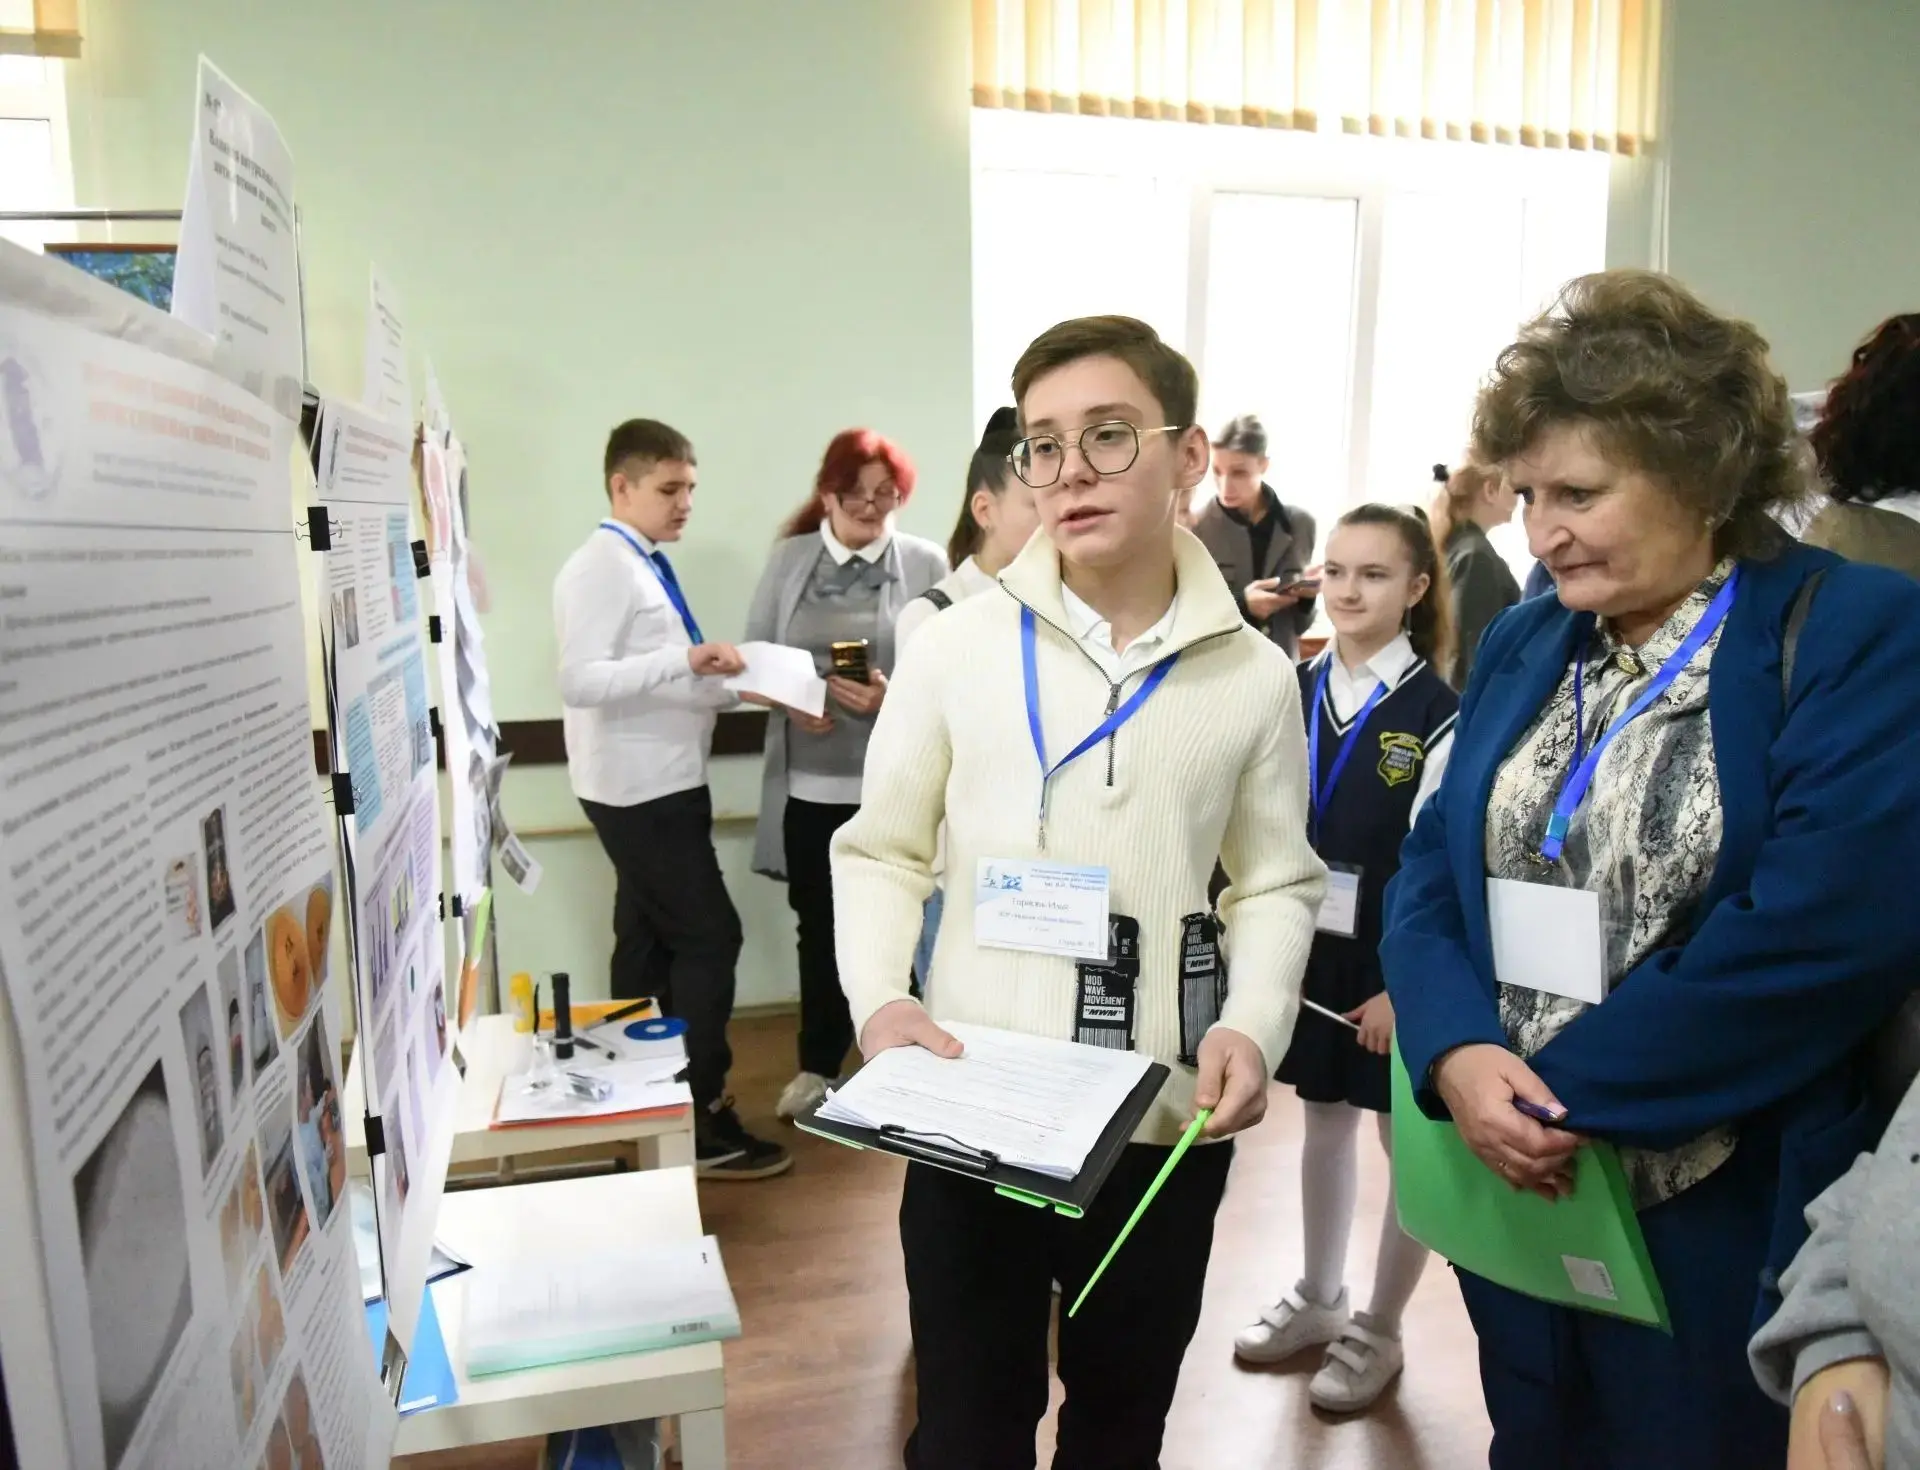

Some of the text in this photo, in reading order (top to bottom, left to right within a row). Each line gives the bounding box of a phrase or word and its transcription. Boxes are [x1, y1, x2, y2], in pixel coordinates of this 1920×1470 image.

[1187, 933, 1203, 944] WAVE
[1085, 975, 1102, 986] MOD
[1085, 985, 1107, 996] WAVE
[1084, 995, 1126, 1006] MOVEMENT
